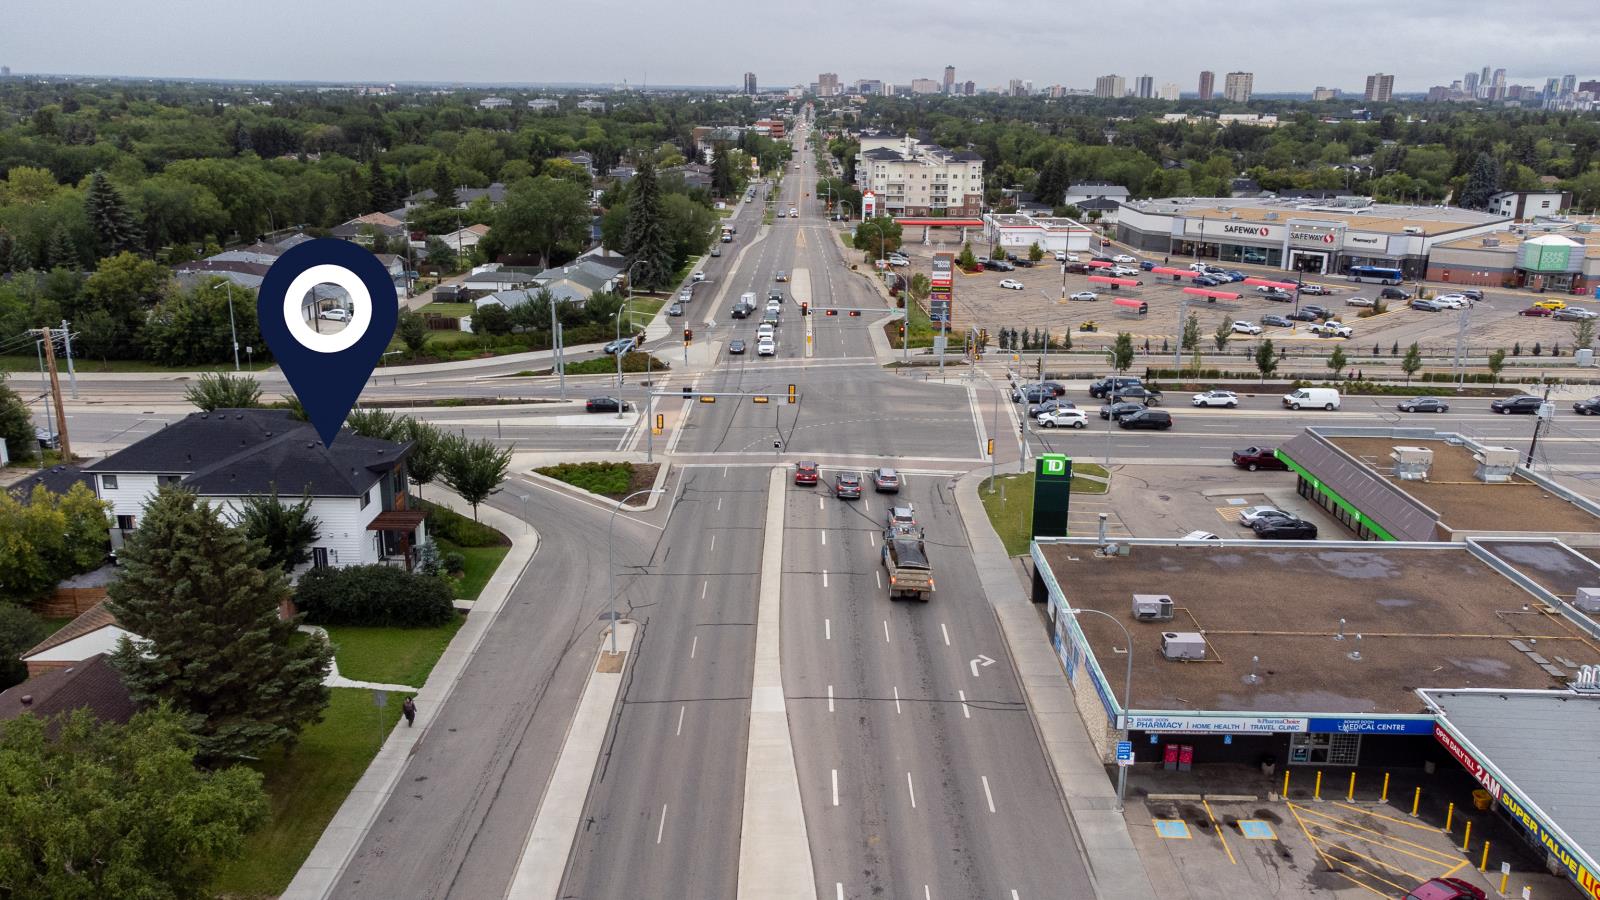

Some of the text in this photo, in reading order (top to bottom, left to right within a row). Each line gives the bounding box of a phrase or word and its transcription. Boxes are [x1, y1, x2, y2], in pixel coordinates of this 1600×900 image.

[1224, 225, 1259, 235] SAFEWAY
[1290, 232, 1323, 241] SAFEWAY
[1045, 460, 1063, 471] TD
[1136, 721, 1183, 729] PHARMACY
[1435, 727, 1450, 746] OPEN
[1449, 740, 1464, 759] DAILY
[1464, 756, 1475, 771] TILL
[1502, 792, 1538, 835] SUPER
[1540, 829, 1578, 874] VALUE
